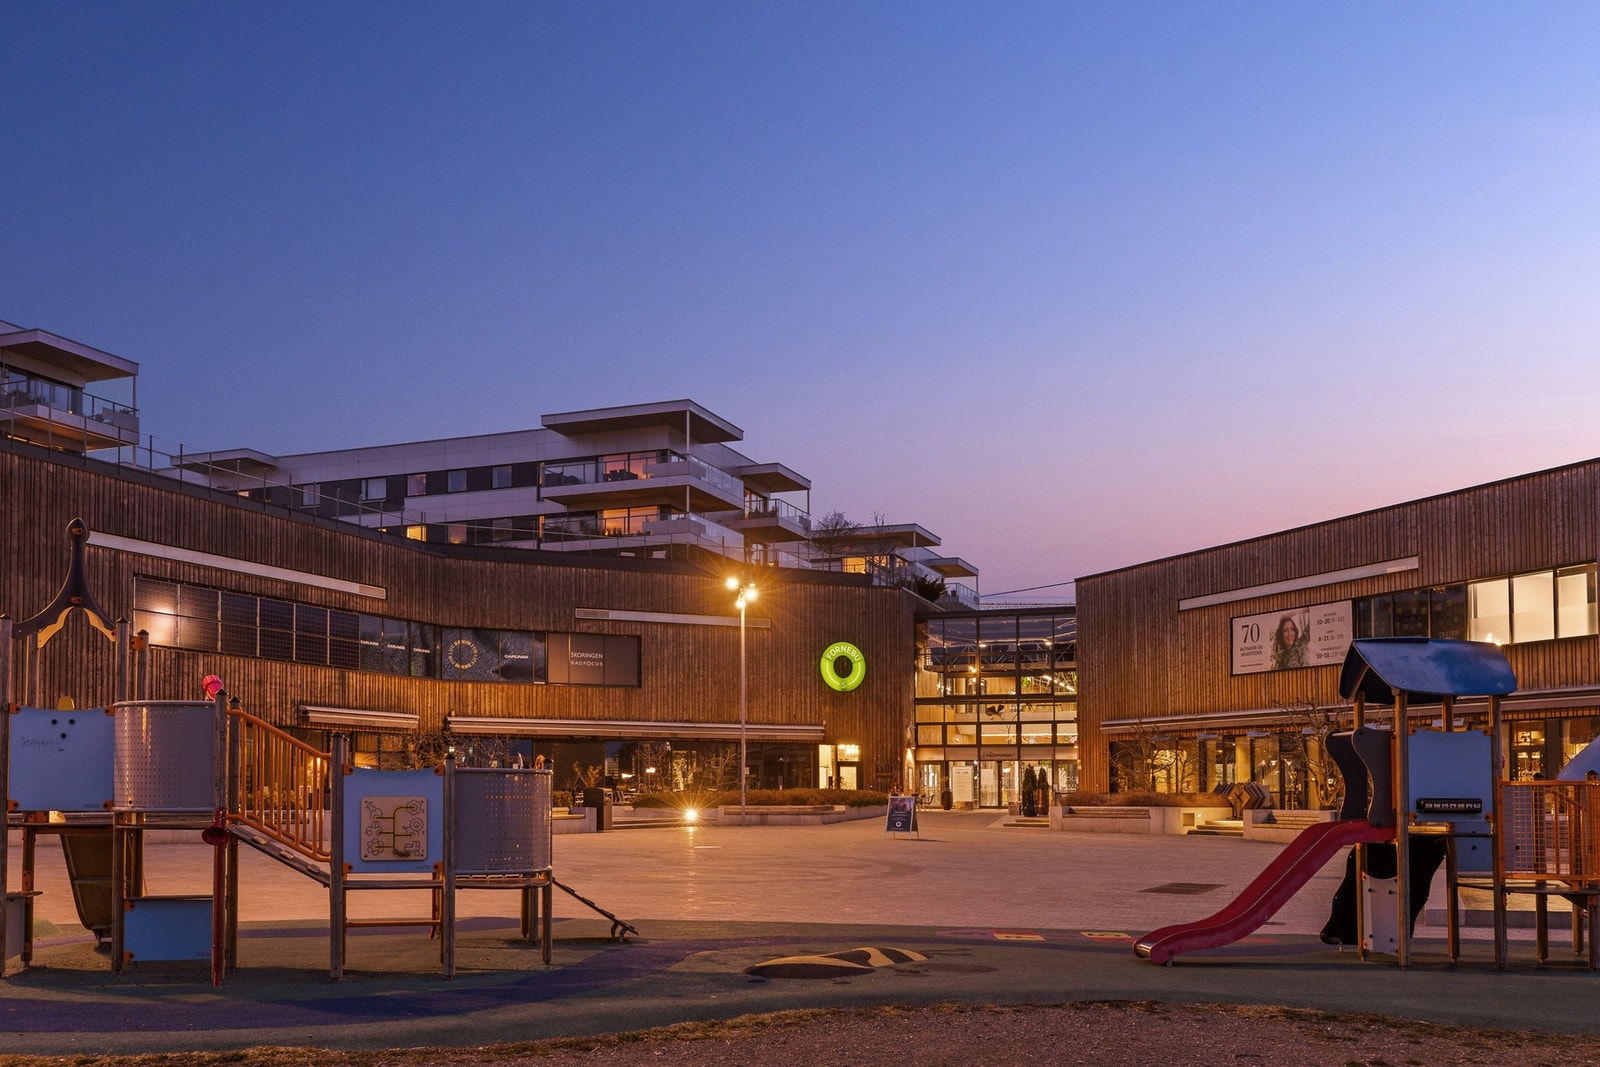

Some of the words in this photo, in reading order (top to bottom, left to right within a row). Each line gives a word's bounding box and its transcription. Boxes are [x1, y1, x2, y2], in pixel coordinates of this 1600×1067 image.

[1242, 623, 1260, 643] 70
[826, 645, 861, 662] FORNEBU
[841, 681, 847, 689] S
